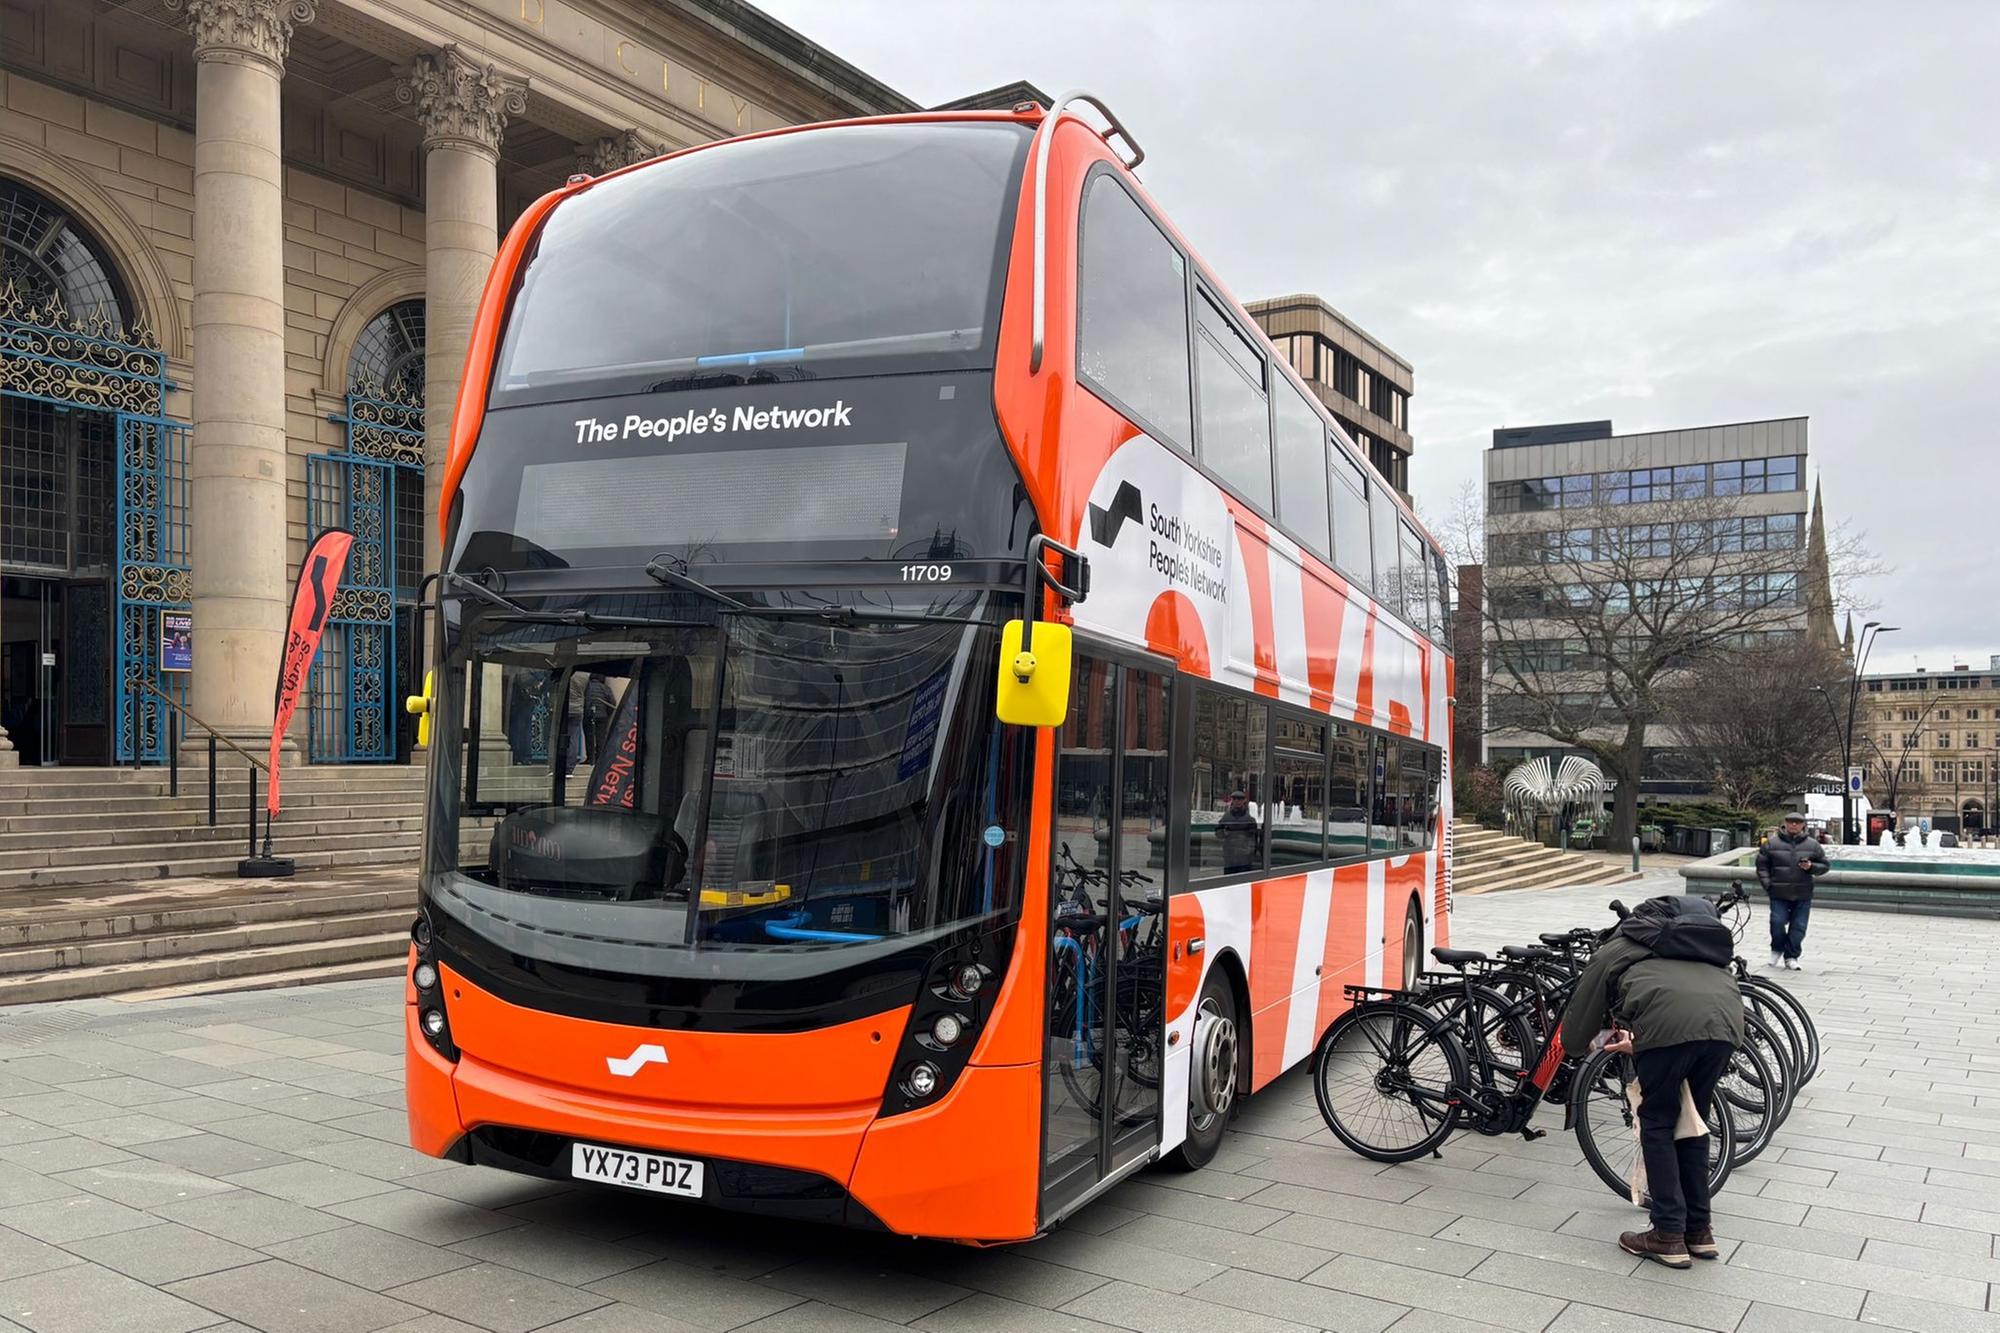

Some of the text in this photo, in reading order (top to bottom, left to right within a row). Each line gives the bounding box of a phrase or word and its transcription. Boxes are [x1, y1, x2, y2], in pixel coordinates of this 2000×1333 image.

[616, 41, 747, 128] CITY
[575, 400, 852, 443] The People's Network
[1150, 502, 1222, 568] South Yorkshire
[900, 565, 952, 581] 11709
[1190, 562, 1226, 604] Network
[285, 640, 311, 692] South
[583, 1147, 693, 1190] YX73 PDZ
